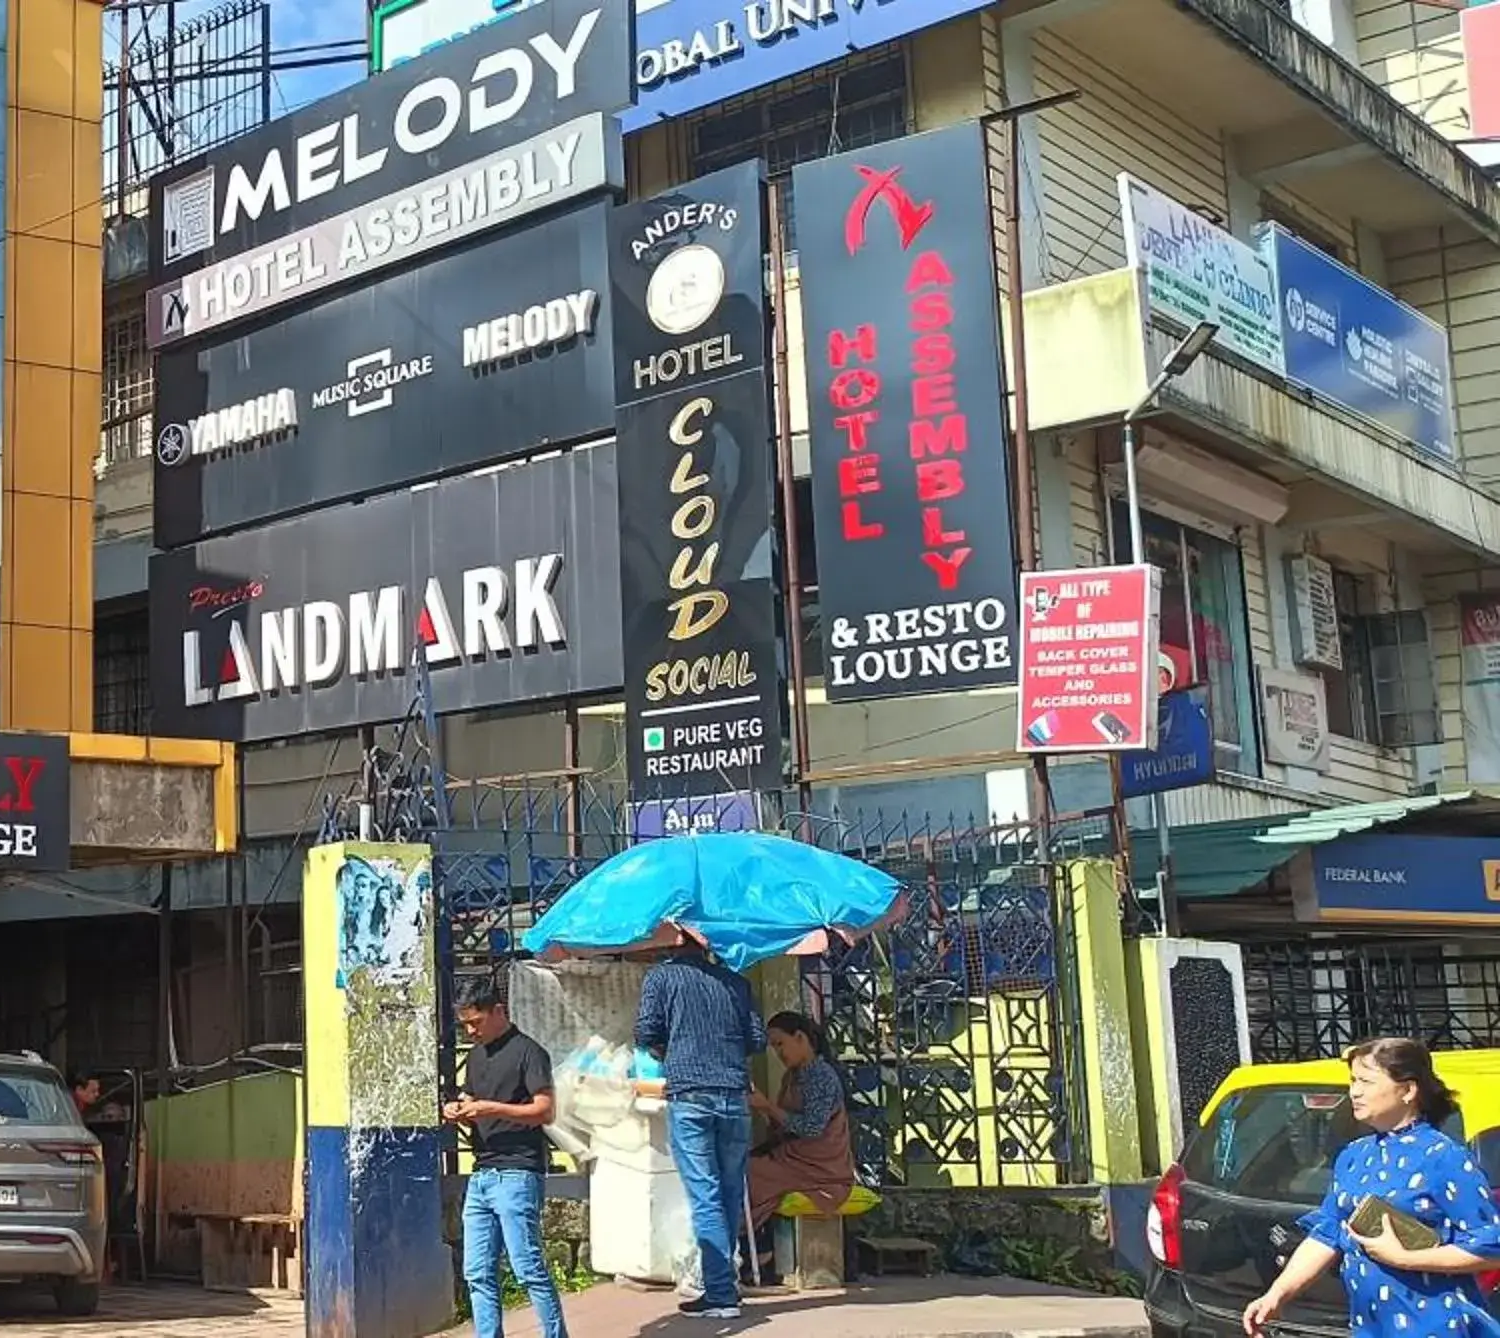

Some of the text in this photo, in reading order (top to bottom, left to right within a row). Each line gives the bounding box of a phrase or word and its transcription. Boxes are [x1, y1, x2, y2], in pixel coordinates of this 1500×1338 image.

[220, 9, 601, 233] MELODY
[199, 131, 585, 322] HOTEL ASSEMBLY
[631, 203, 738, 261] ANDER'S
[463, 290, 599, 368] MELODY
[312, 355, 434, 410] MUSIC SQUARE
[633, 333, 744, 390] HOTEL
[188, 387, 299, 456] YAMAHA
[828, 322, 884, 541] HOTEL
[905, 250, 972, 590] ASSEMBLY
[668, 397, 729, 641] CLOUD
[1059, 579, 1113, 599] ALL TYPE
[1076, 602, 1093, 619] OF
[183, 553, 568, 706] LANDMARK
[831, 598, 1006, 650] & RESTO
[1029, 621, 1140, 643] MOBILE REPAIRING
[645, 650, 757, 701] SOCIAL
[831, 637, 1012, 686] LOUNGE
[1028, 661, 1137, 677] TEMPER GLASS
[1037, 645, 1129, 662] BACK COVER
[1031, 692, 1133, 708] ACCESSORIES
[1064, 679, 1095, 691] AND
[673, 717, 763, 747] PURE VEG
[646, 745, 765, 776] RESTAURANT
[1325, 867, 1408, 885] FEDERAL BANK
